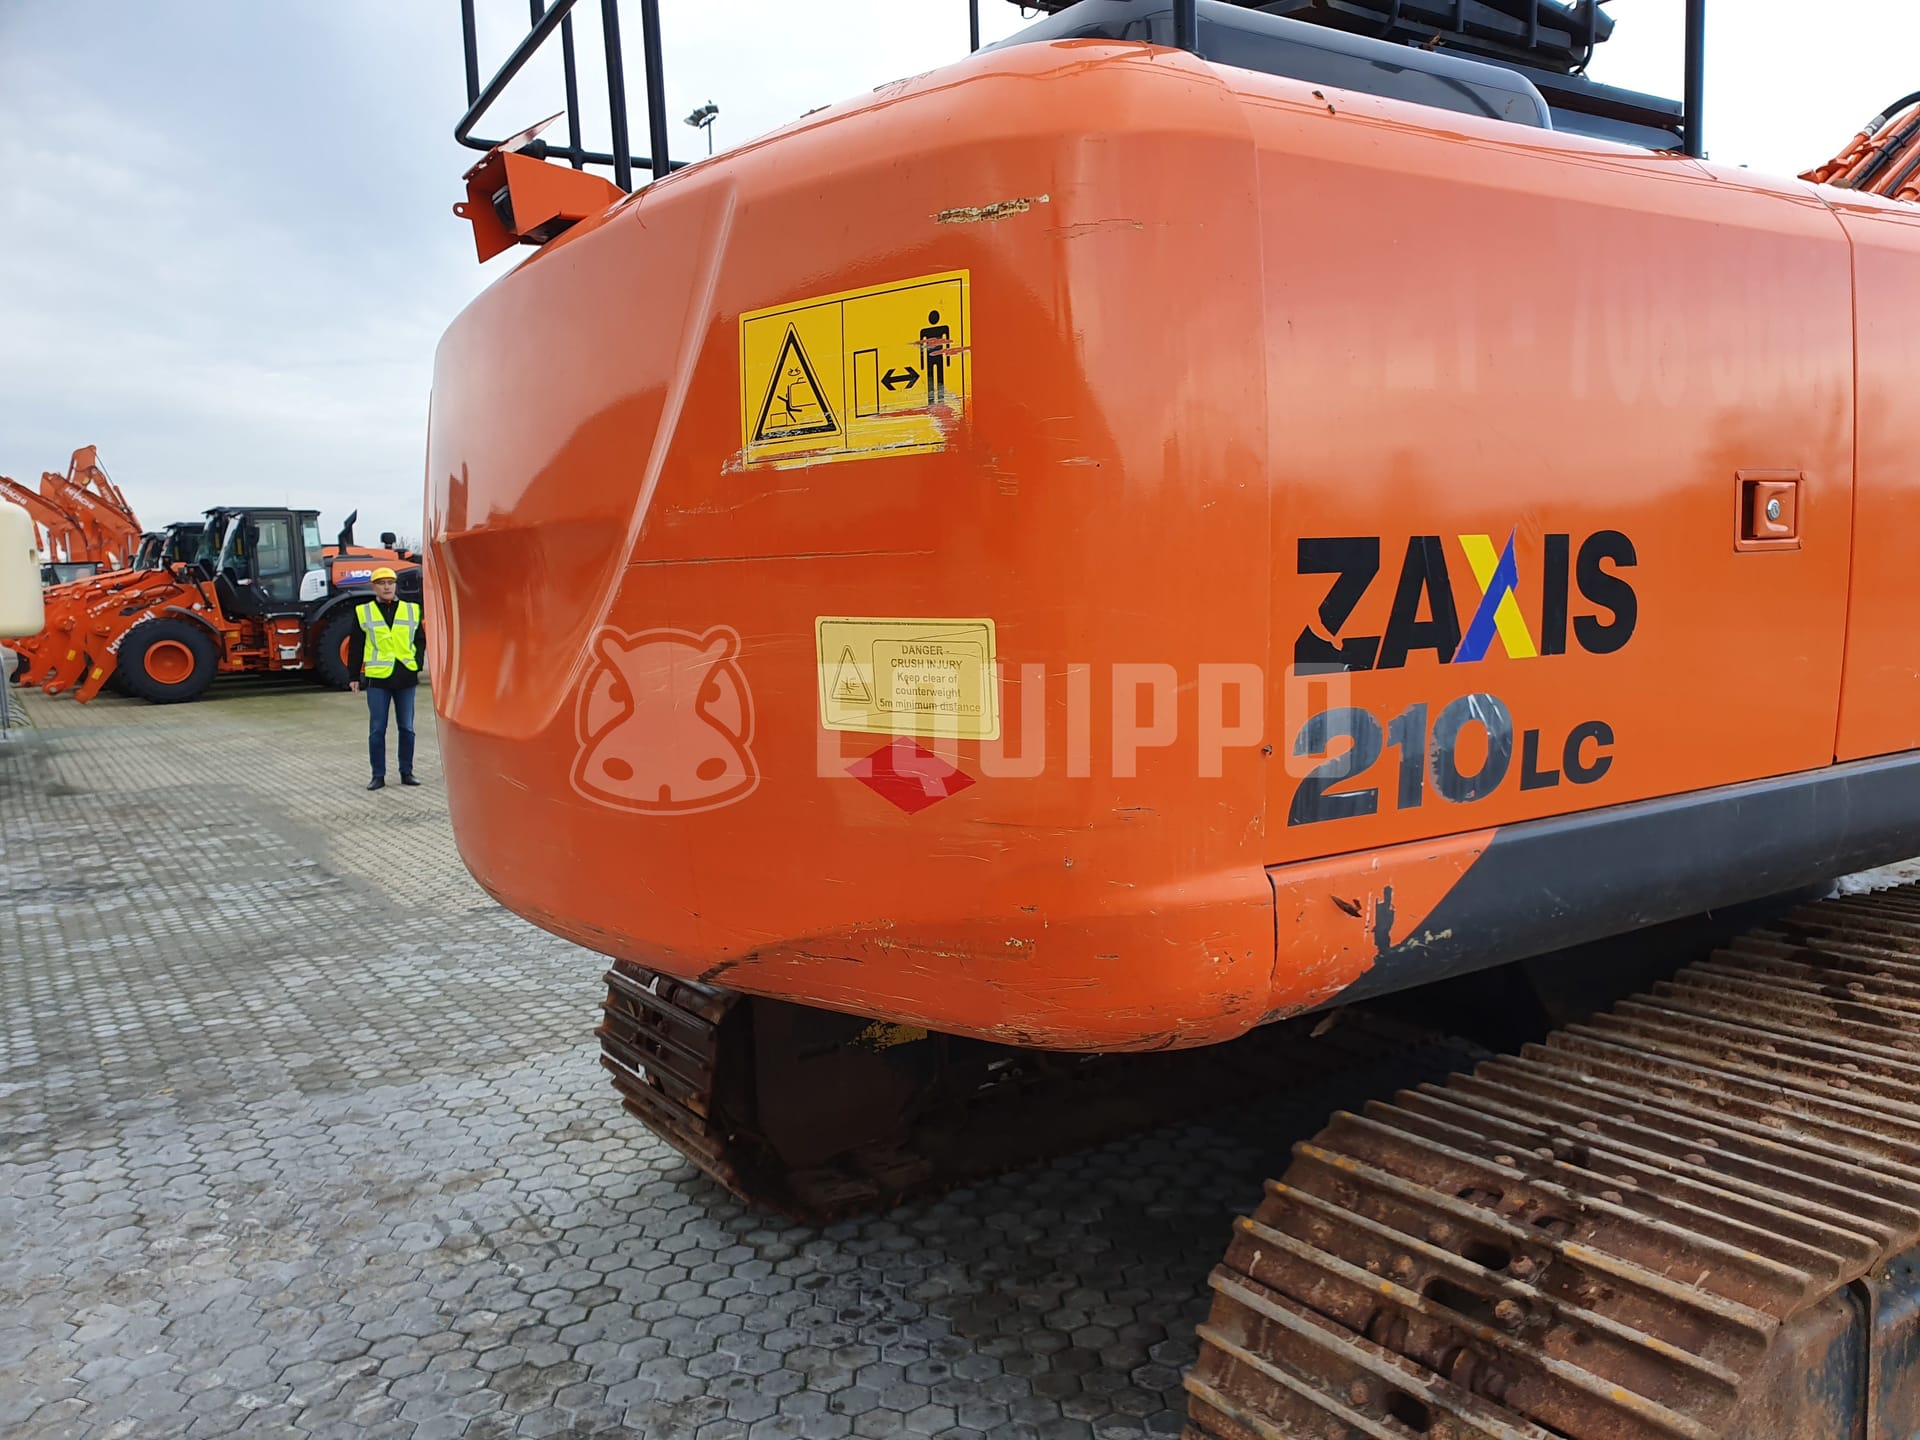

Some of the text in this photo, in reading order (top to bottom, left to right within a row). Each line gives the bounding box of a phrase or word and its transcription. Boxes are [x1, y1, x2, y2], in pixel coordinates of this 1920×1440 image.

[1293, 524, 1638, 677] ZAXIS
[901, 645, 944, 656] DANGER
[890, 658, 963, 670] CRUSH INJURY
[897, 672, 959, 684] Keep clear of
[895, 687, 961, 700] counterweight
[880, 698, 981, 712] 5m minimum distance
